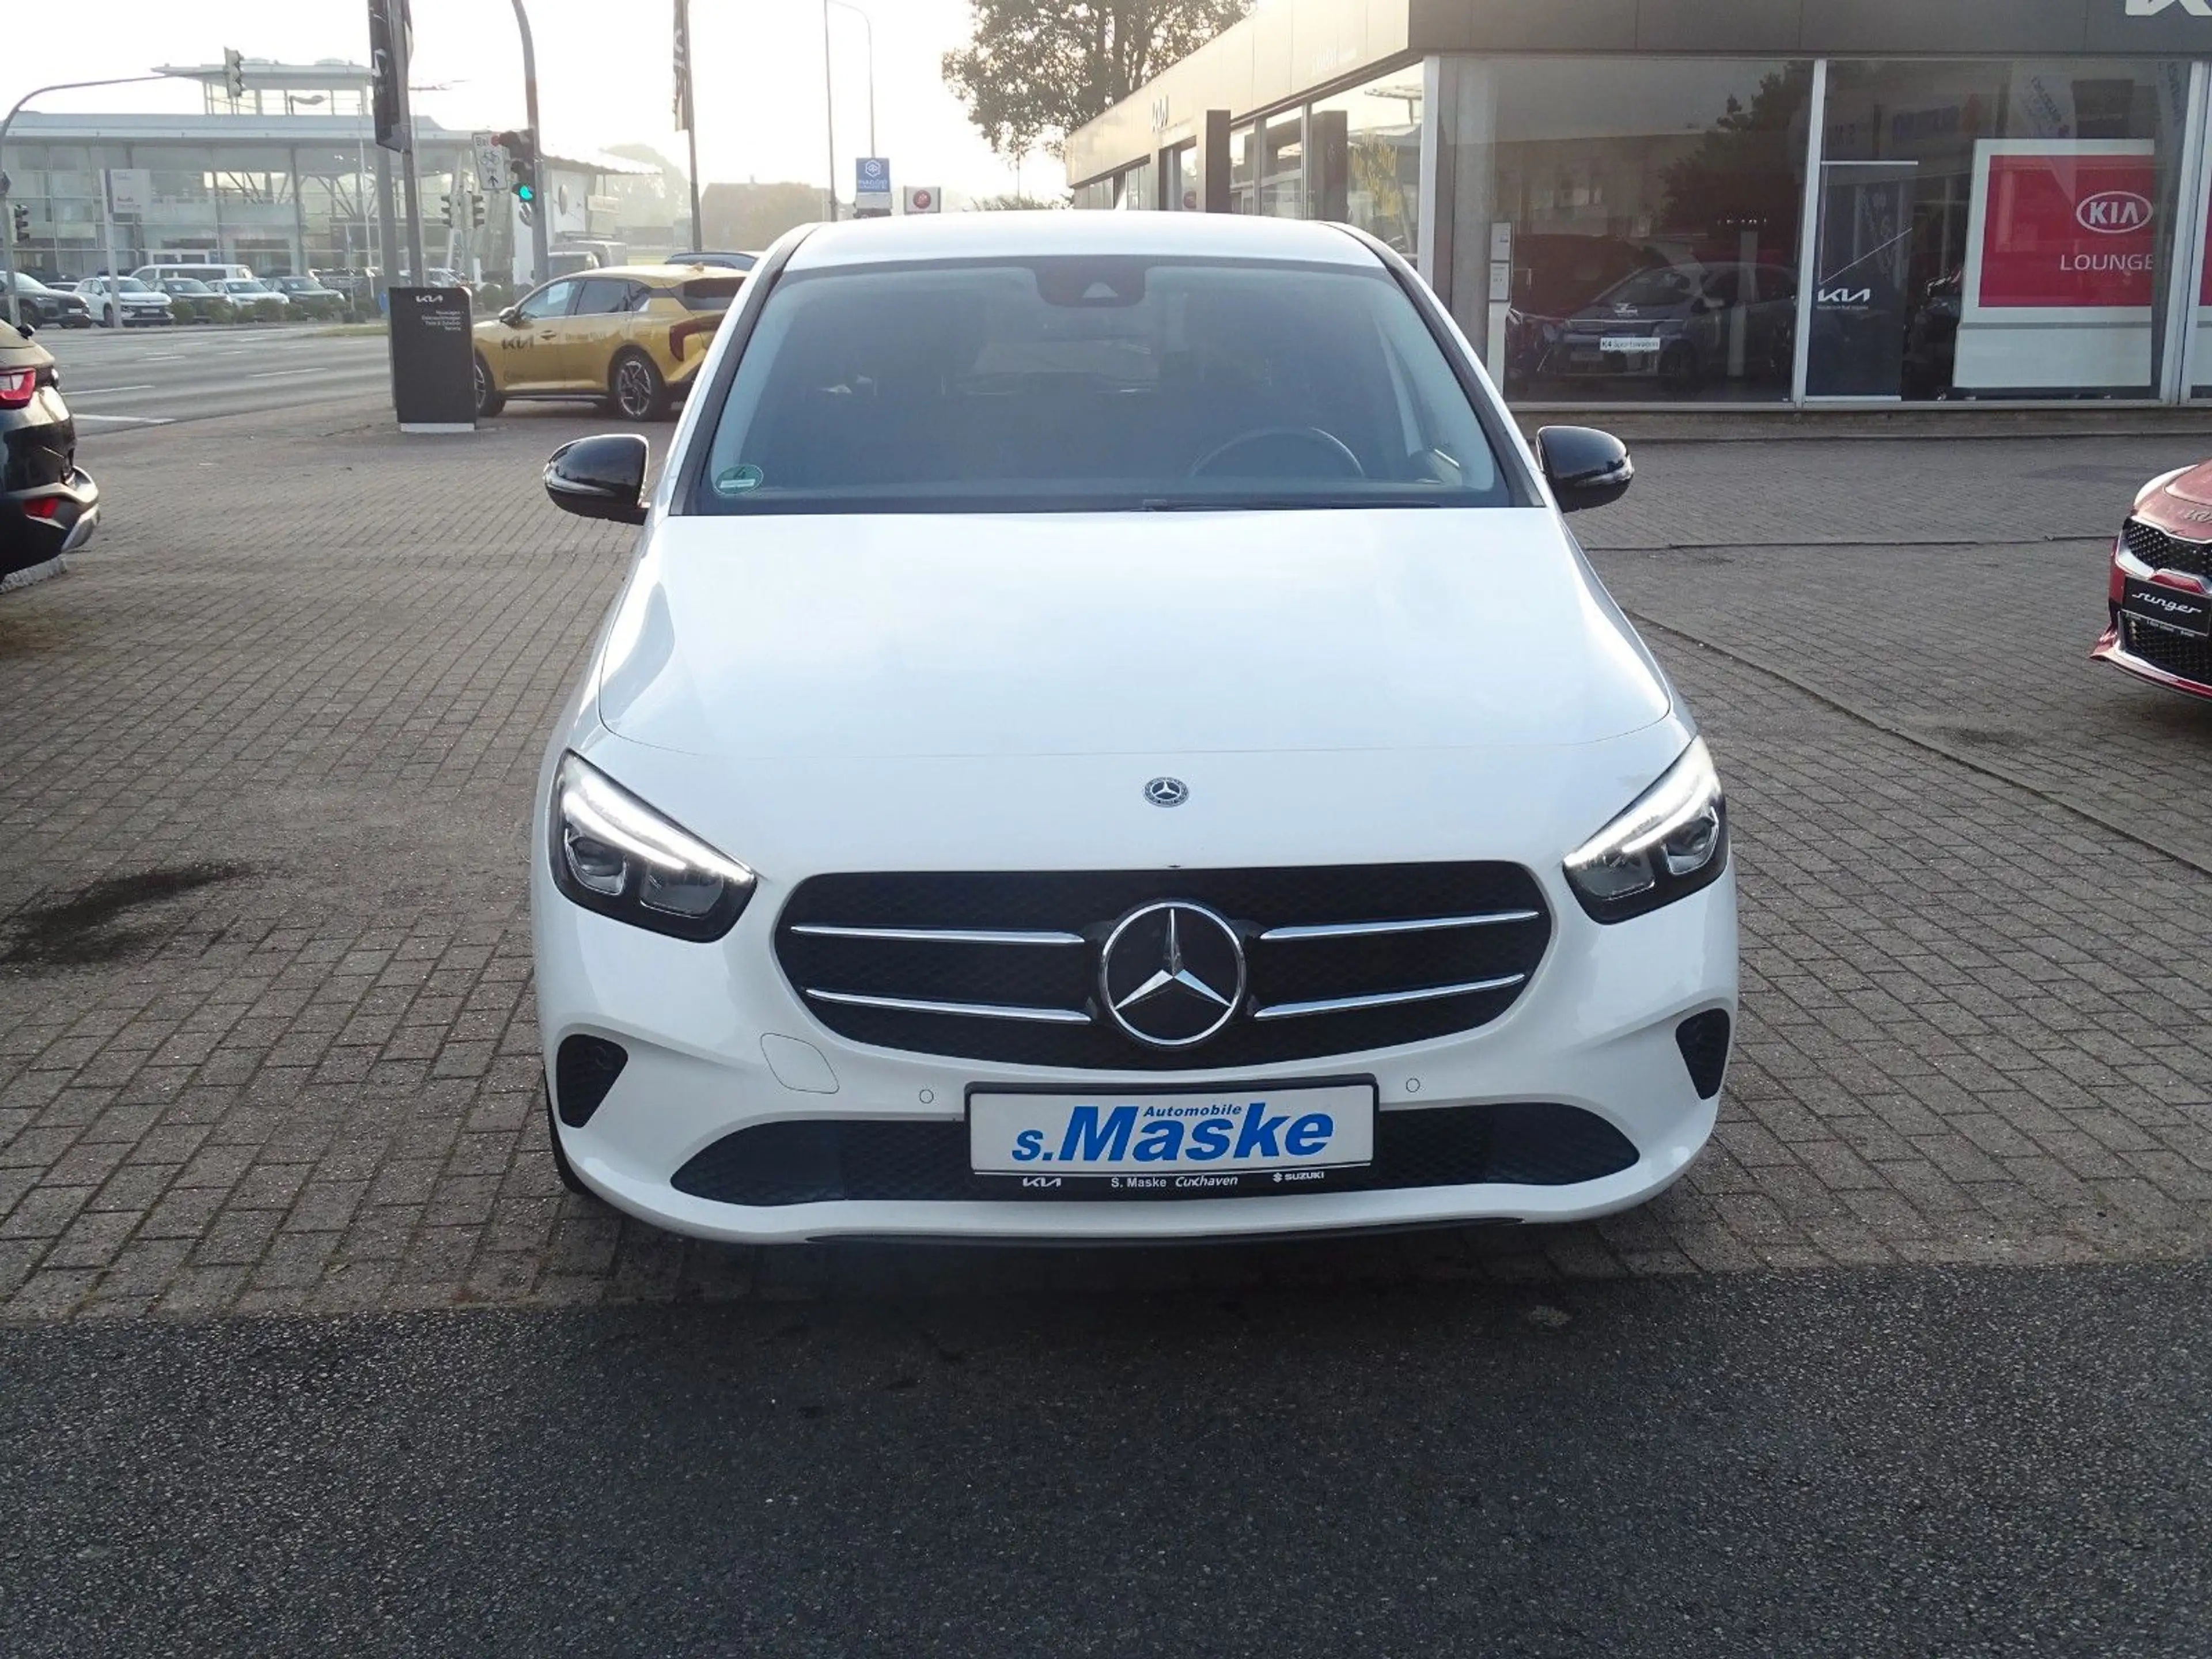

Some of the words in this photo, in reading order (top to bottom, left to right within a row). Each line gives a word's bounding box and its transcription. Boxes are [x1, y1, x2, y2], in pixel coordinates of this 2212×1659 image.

[2089, 201, 2139, 224] KIA
[2060, 253, 2154, 271] LOUNGE
[415, 294, 444, 303] KIA
[1817, 287, 1871, 302] KIA
[1143, 1104, 1242, 1117] Automobile
[1022, 1177, 1062, 1187] KIA
[1111, 1177, 1123, 1188] S.
[1127, 1177, 1167, 1187] Maske
[1175, 1176, 1238, 1187] Cuxhaven
[1285, 1172, 1325, 1181] SUZUKI
